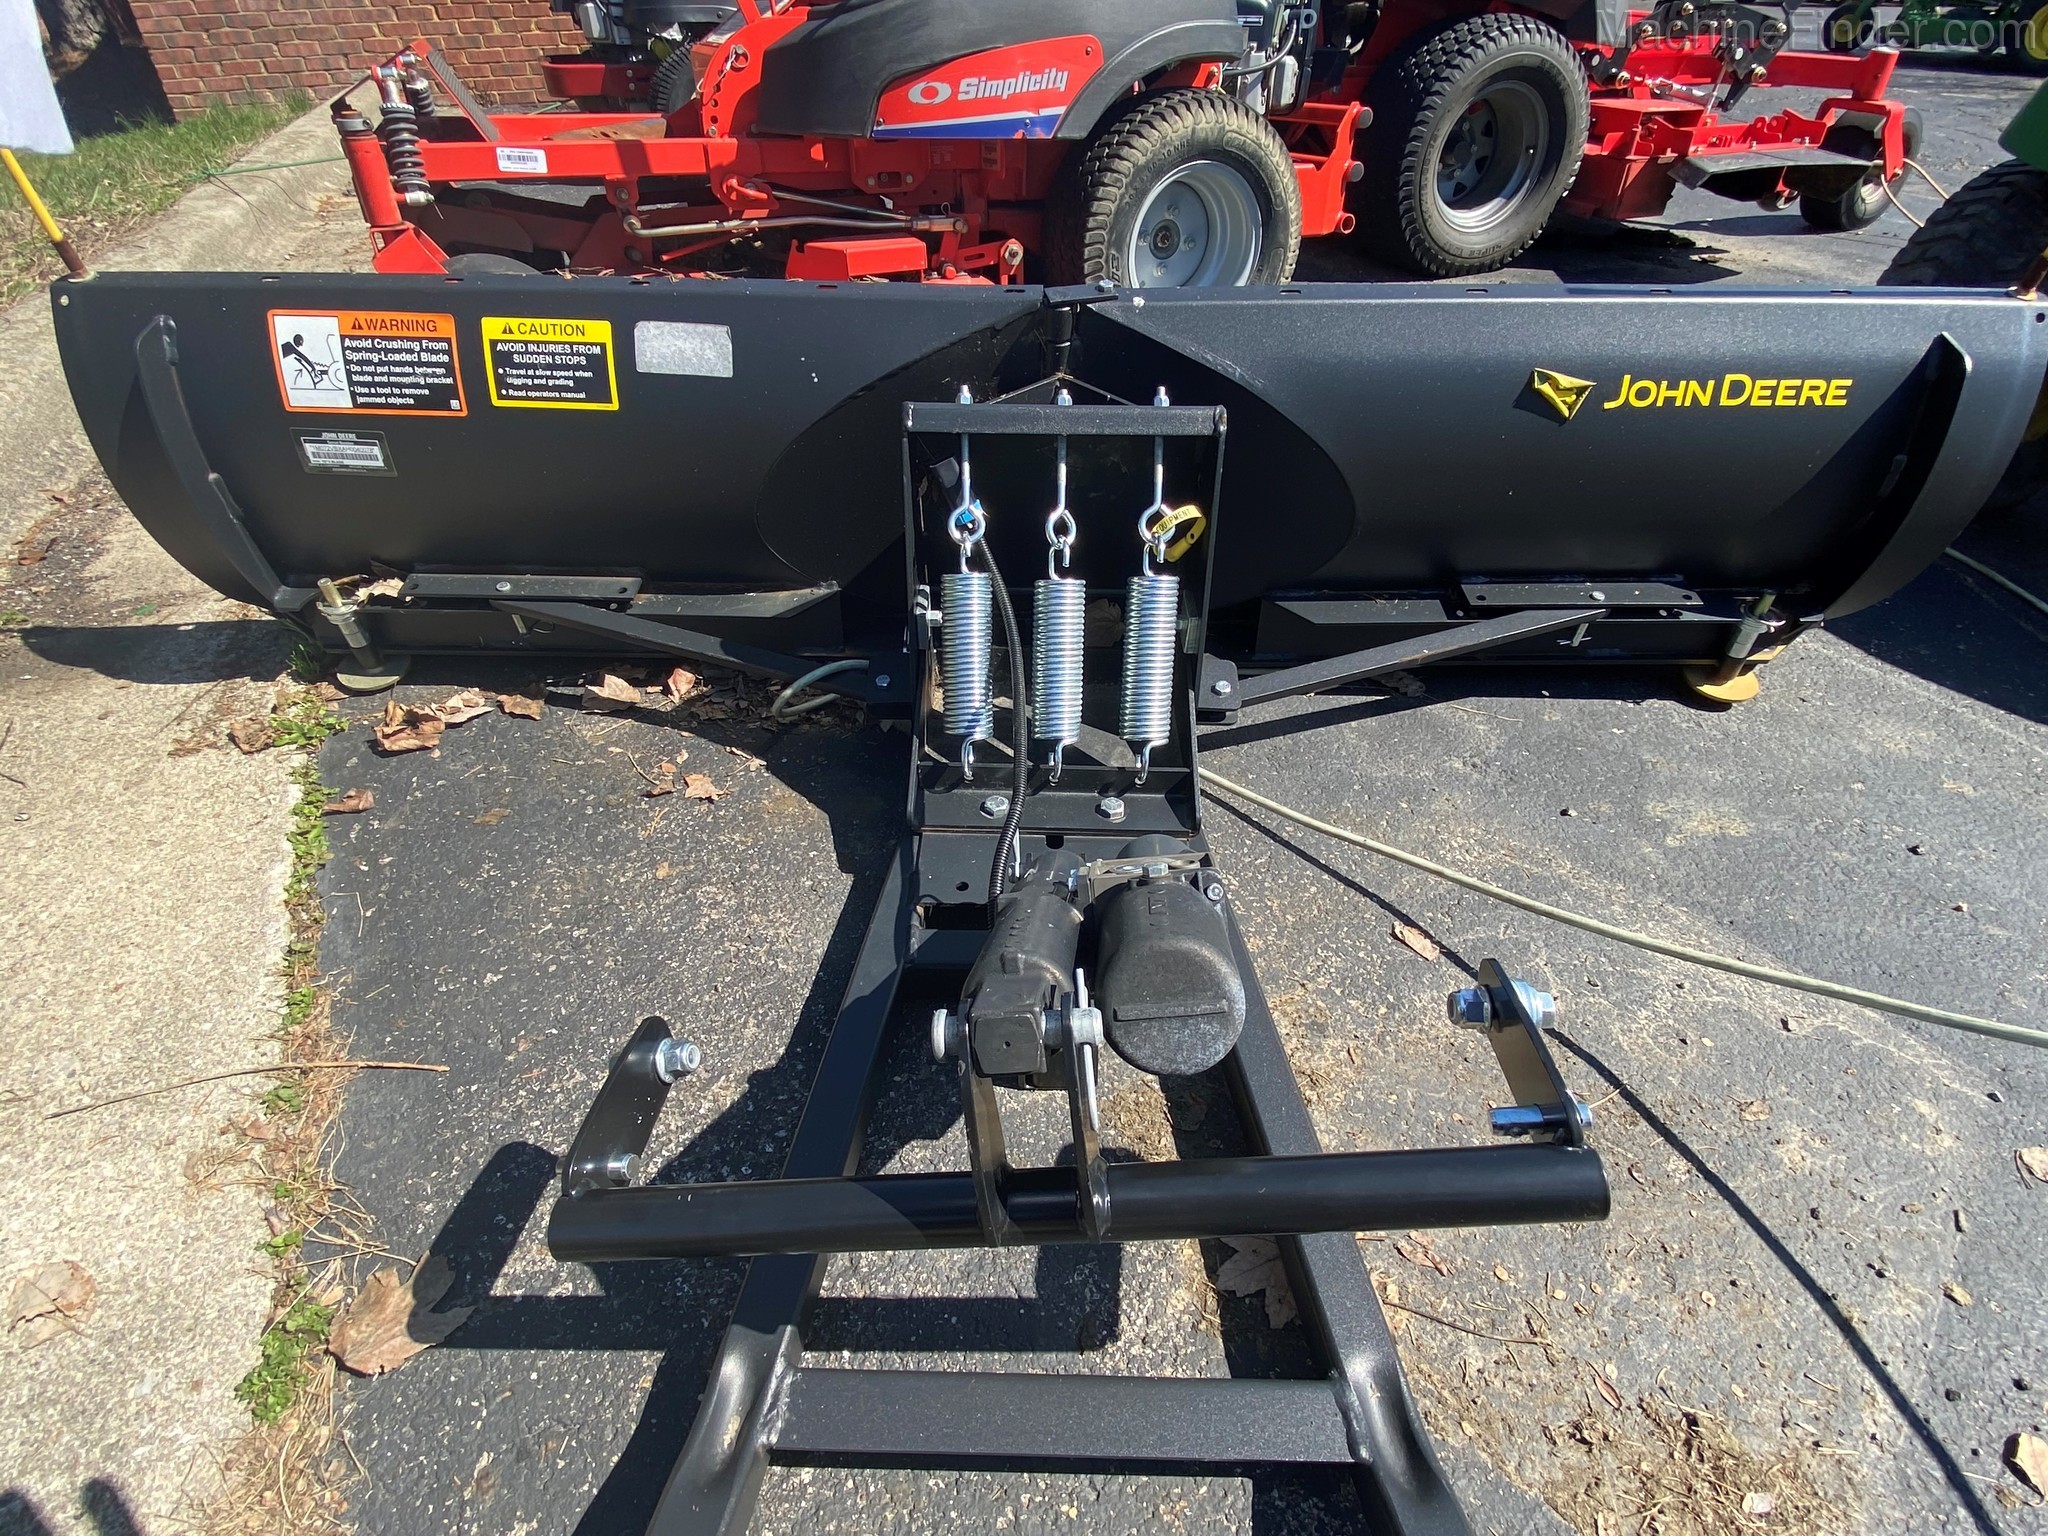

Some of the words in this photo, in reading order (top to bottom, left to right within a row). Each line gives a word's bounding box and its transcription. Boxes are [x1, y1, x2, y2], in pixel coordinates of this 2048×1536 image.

[957, 67, 1069, 101] Simplicity
[364, 318, 438, 333] WARNING
[517, 322, 586, 336] CAUTION
[344, 338, 372, 349] Avoid
[374, 339, 420, 352] Crushing
[422, 340, 449, 350] From
[496, 343, 525, 352] AVOID
[527, 343, 571, 353] INJURIES
[573, 345, 601, 355] FROM
[345, 350, 418, 363] Spring-Loaded
[421, 352, 450, 363] Blade
[512, 354, 552, 364] SUDDEN
[554, 355, 587, 365] STOPS
[350, 364, 361, 372] Do
[363, 365, 376, 373] not
[377, 365, 390, 374] put
[390, 365, 413, 373] hands
[552, 369, 573, 378] speed
[352, 374, 373, 382] blade
[426, 376, 454, 384] bracket
[533, 377, 547, 385] and
[547, 378, 574, 387] grading
[377, 386, 392, 394] tool
[527, 389, 560, 398] operators
[561, 391, 586, 399] manual
[1603, 374, 1715, 410] JOHN
[1719, 373, 1853, 407] DEERE
[356, 396, 386, 404] jammed
[387, 396, 415, 405] objects
[1155, 508, 1192, 532] EQUIPMENT
